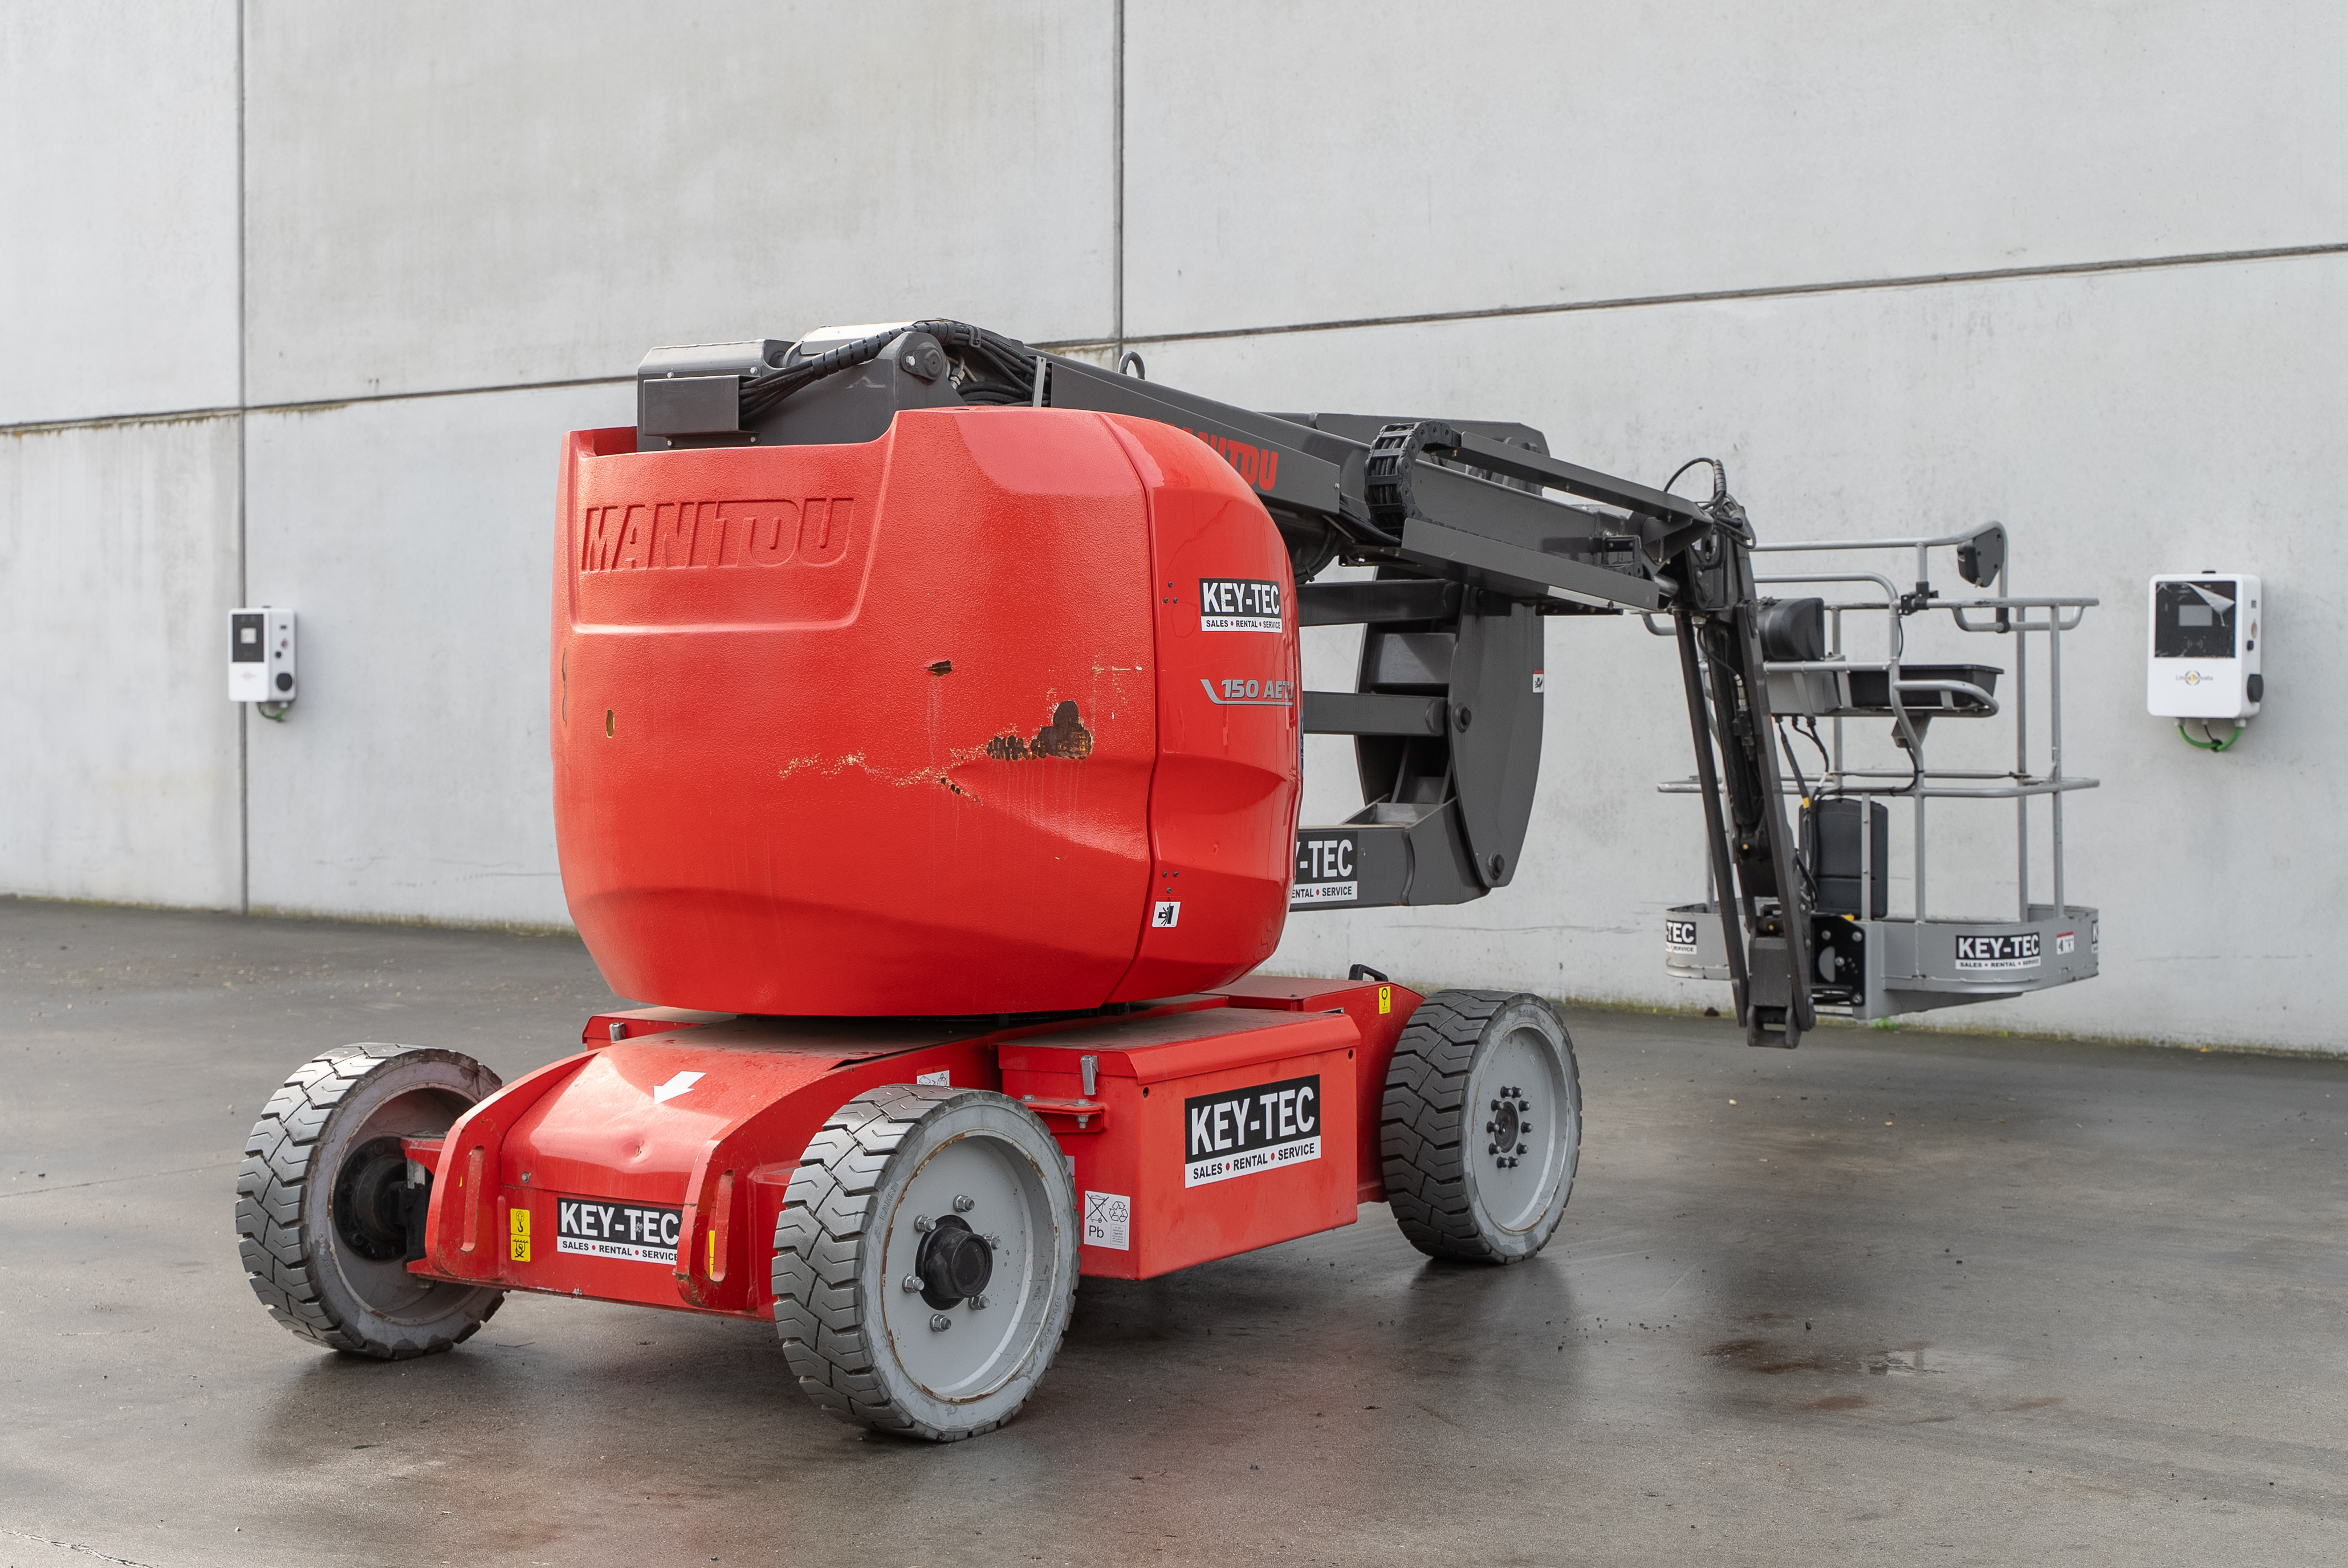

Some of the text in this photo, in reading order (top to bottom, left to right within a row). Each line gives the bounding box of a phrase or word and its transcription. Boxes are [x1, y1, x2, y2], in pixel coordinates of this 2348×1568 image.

[581, 498, 854, 572] MANITOU
[1203, 583, 1280, 614] KEY-TEC
[1263, 621, 1281, 629] SERVICE
[1221, 679, 1294, 699] 150 AETJ
[1296, 839, 1353, 878] -TEC
[1292, 886, 1352, 898] ENTAL SERVICE
[1958, 934, 2039, 958] KEY-TEC
[1192, 1086, 1315, 1155] KEY-TEC
[1193, 1142, 1315, 1180] SALES RENTAL SERVICE
[561, 1202, 679, 1245] KEY-TEC
[1089, 1225, 1104, 1238] Pb
[563, 1241, 678, 1261] SALES RENTAL SERVICE
